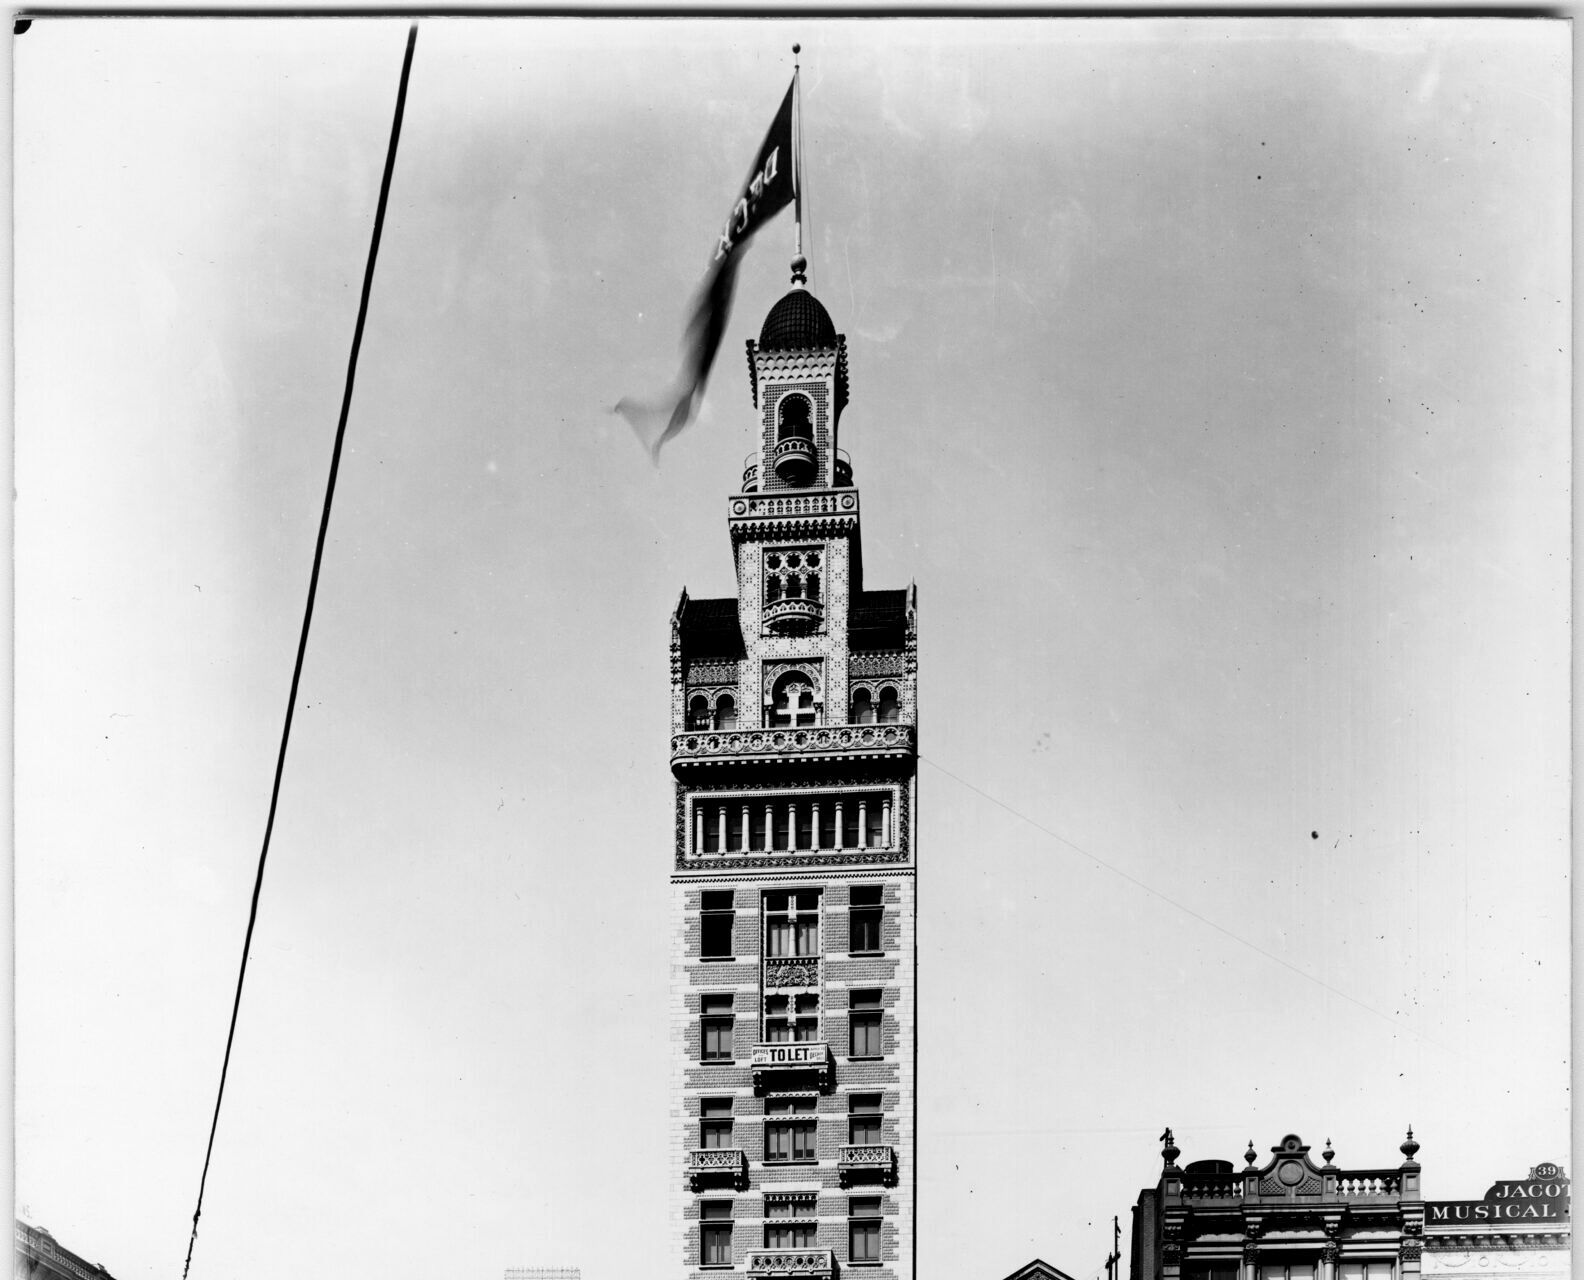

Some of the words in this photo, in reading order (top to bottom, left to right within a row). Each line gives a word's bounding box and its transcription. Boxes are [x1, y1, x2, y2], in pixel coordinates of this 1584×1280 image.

[769, 1048, 786, 1062] TO
[787, 1047, 810, 1062] LET
[1537, 1166, 1557, 1176] 39
[1432, 1203, 1557, 1220] MUSICAL
